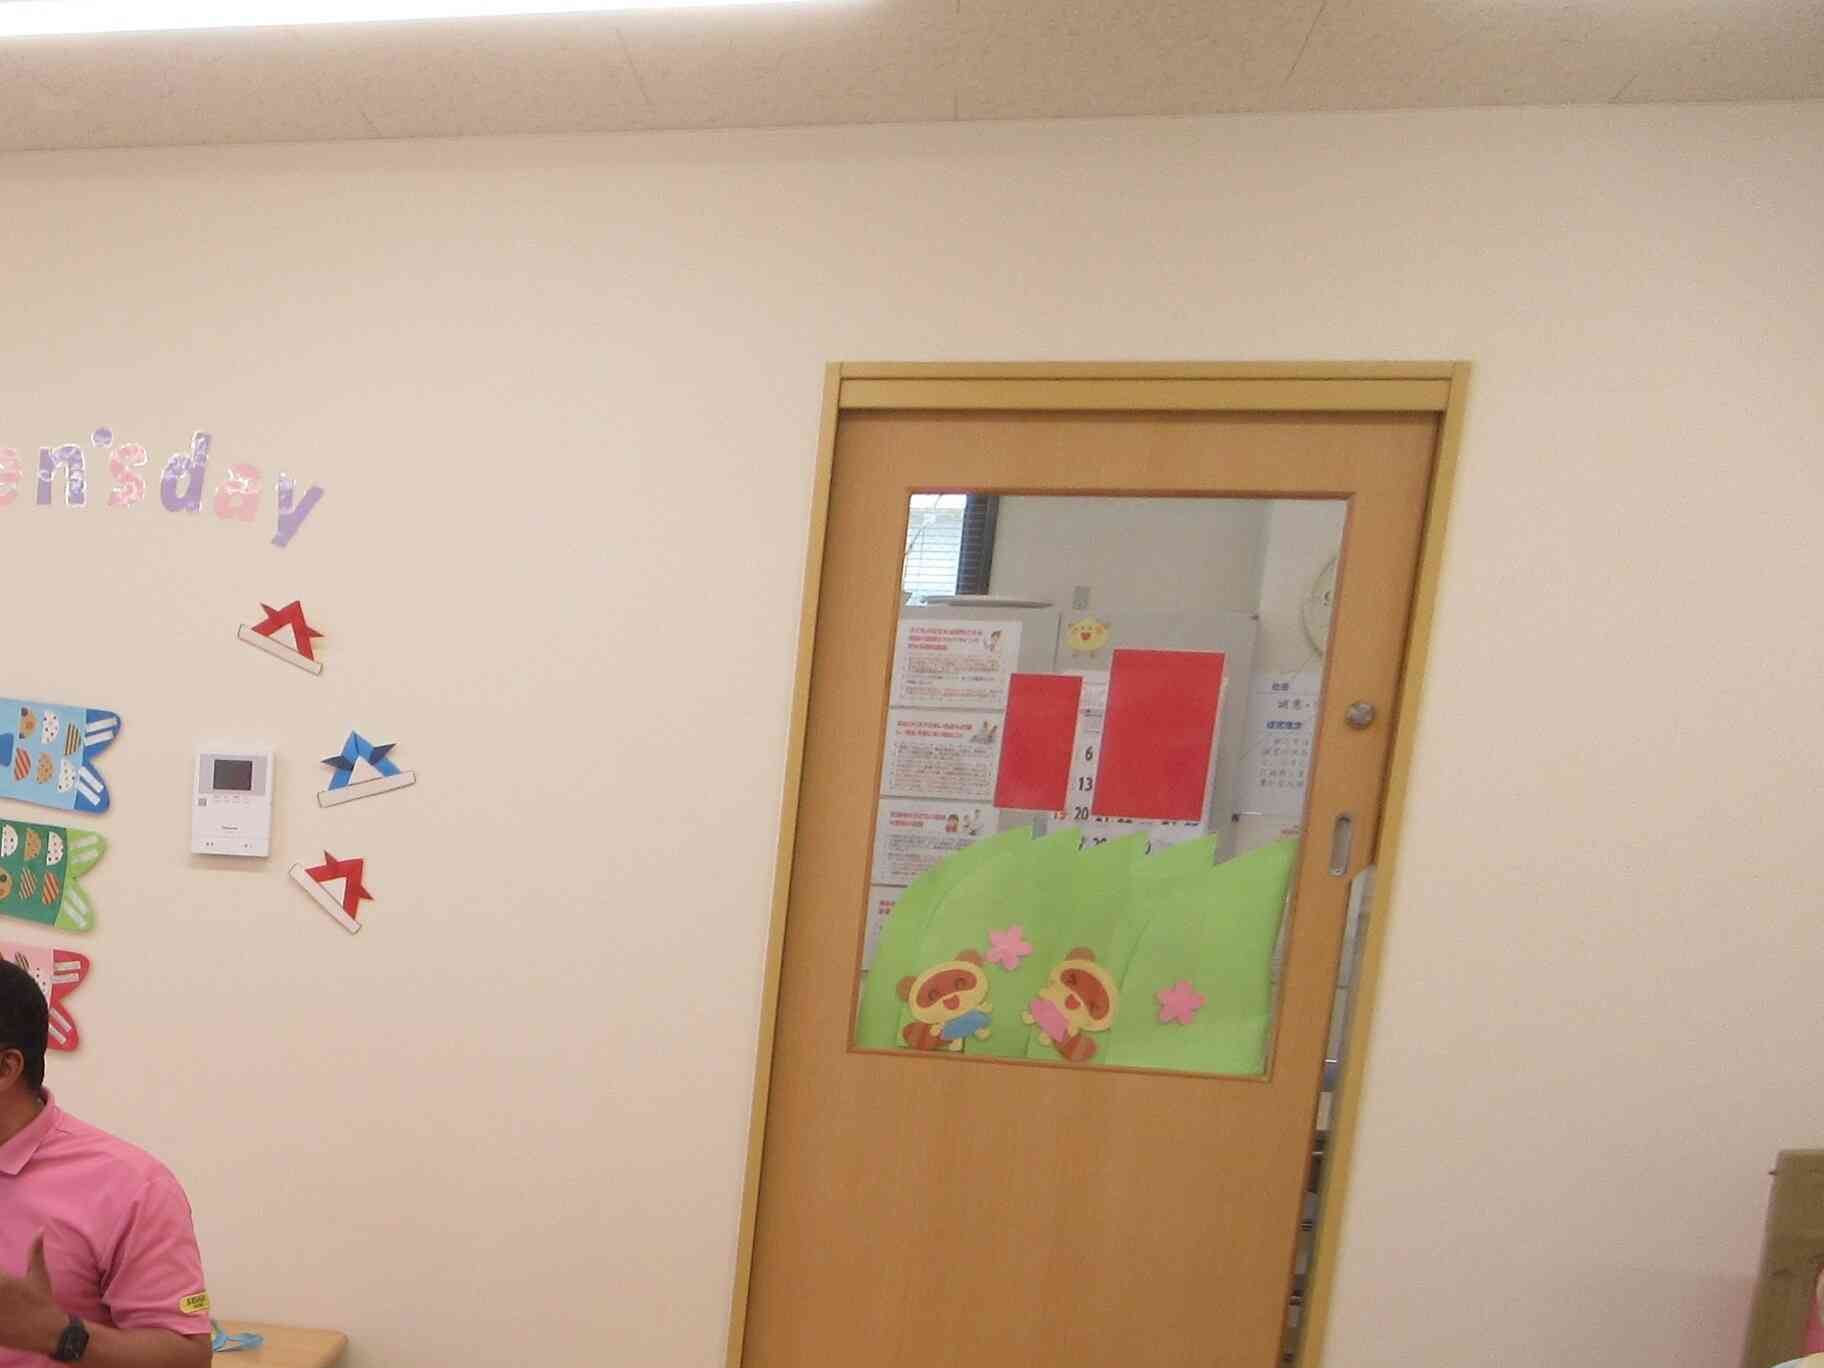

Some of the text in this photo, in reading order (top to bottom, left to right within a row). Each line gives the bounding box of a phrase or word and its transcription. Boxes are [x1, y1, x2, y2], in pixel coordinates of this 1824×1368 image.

[1085, 746, 1094, 761] 6
[1078, 777, 1094, 792] 13
[1074, 806, 1090, 821] 20
